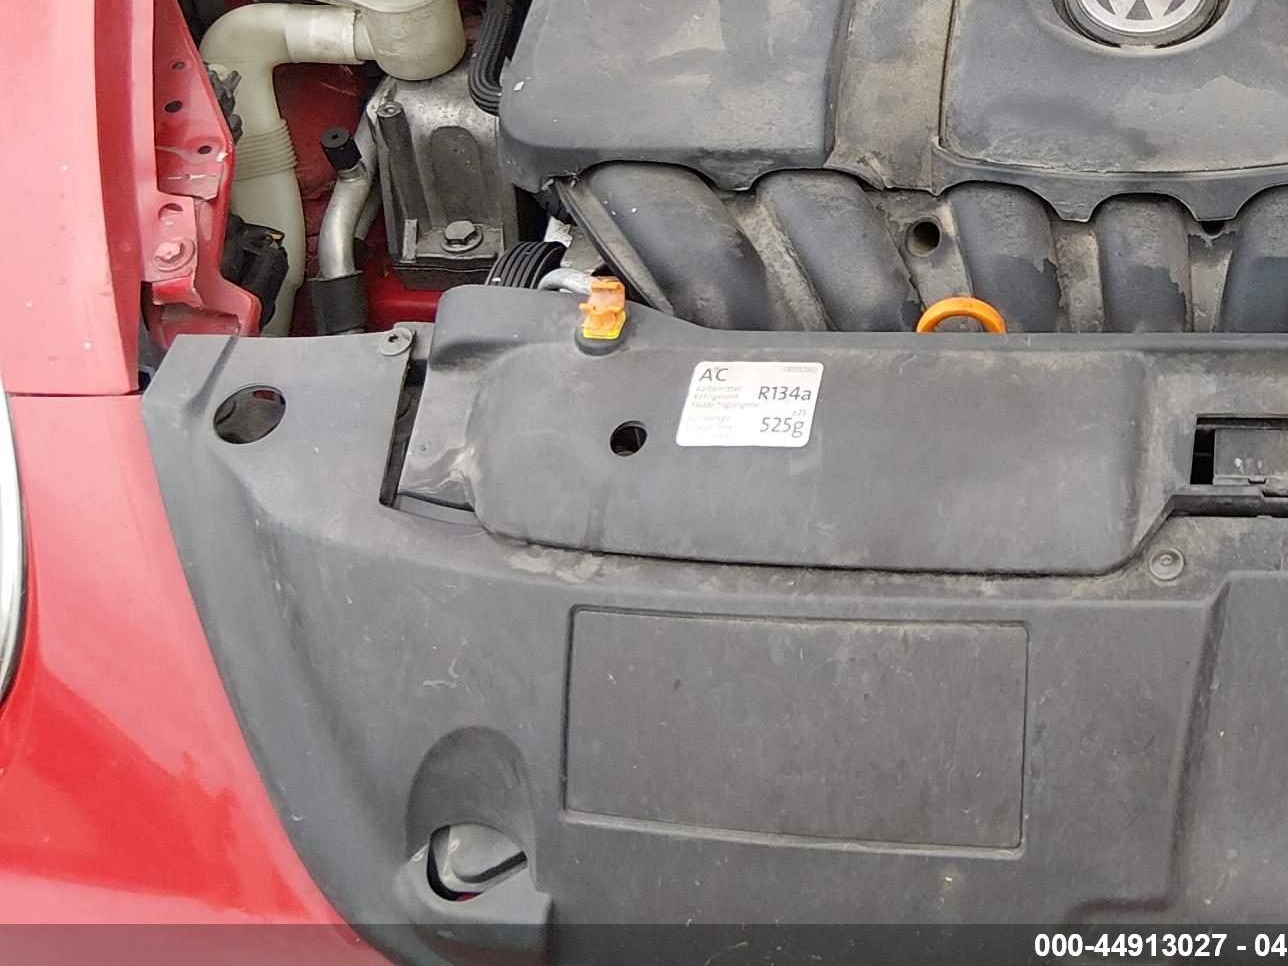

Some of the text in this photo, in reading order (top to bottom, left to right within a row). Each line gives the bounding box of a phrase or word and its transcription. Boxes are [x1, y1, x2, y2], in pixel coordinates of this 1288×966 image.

[699, 367, 729, 382] AC
[758, 385, 812, 401] R134a
[760, 417, 805, 438] 525g
